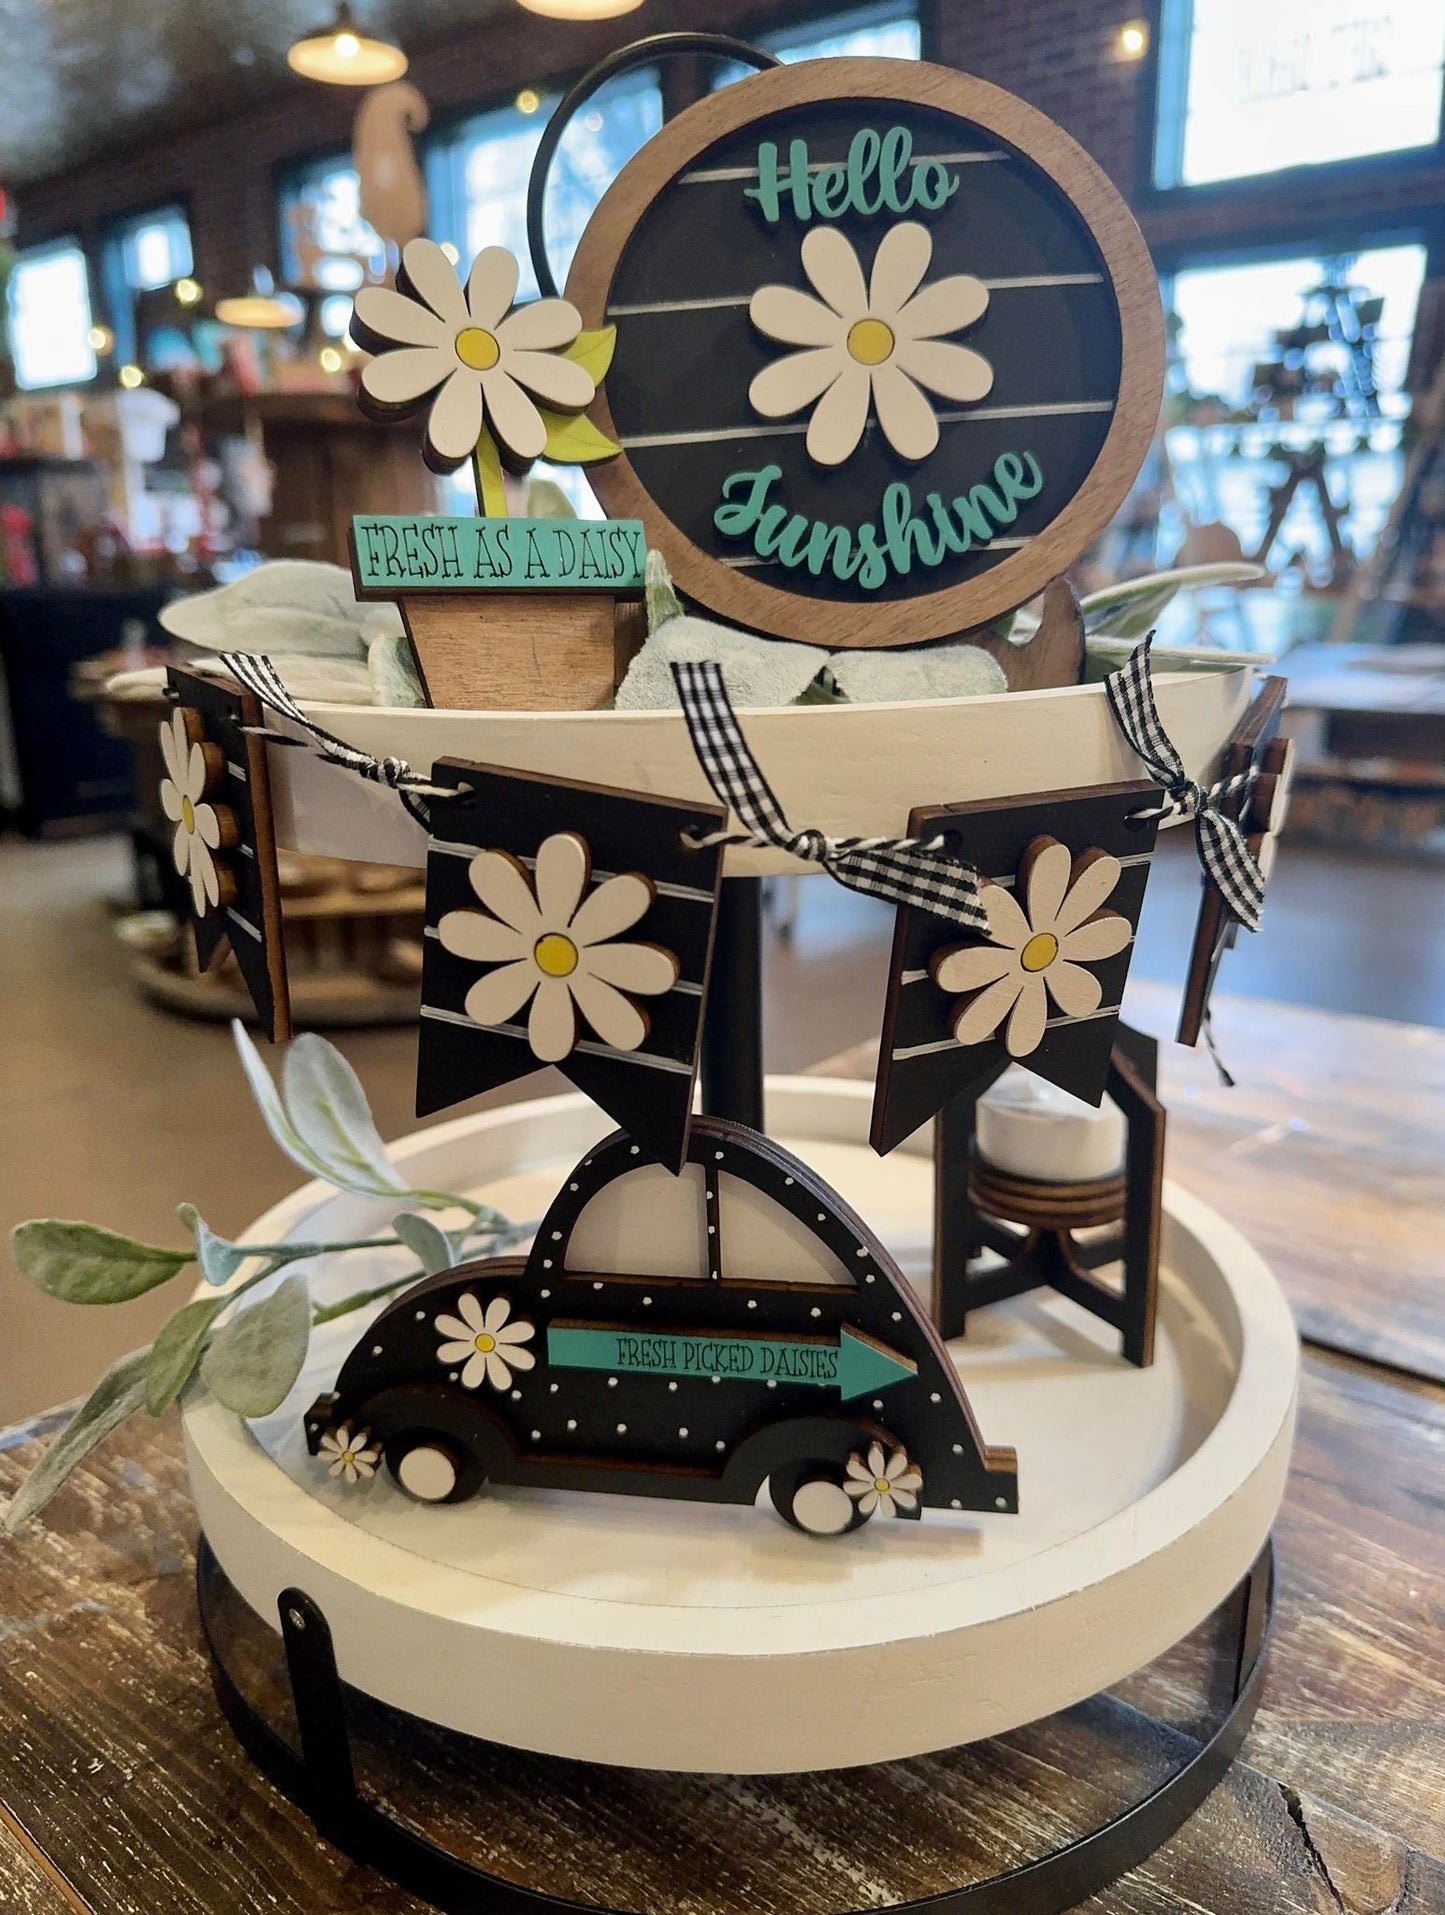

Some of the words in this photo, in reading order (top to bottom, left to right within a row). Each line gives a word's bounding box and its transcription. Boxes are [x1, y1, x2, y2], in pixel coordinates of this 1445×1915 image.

[744, 126, 959, 222] Hello
[361, 523, 464, 579] FRESH
[473, 524, 513, 579] AS
[524, 527, 550, 579] A
[553, 526, 641, 579] DAISY
[714, 450, 1044, 590] Sunshine
[616, 1337, 677, 1368] FRESH
[682, 1341, 754, 1373] PICKED
[760, 1347, 838, 1379] DAISIES
